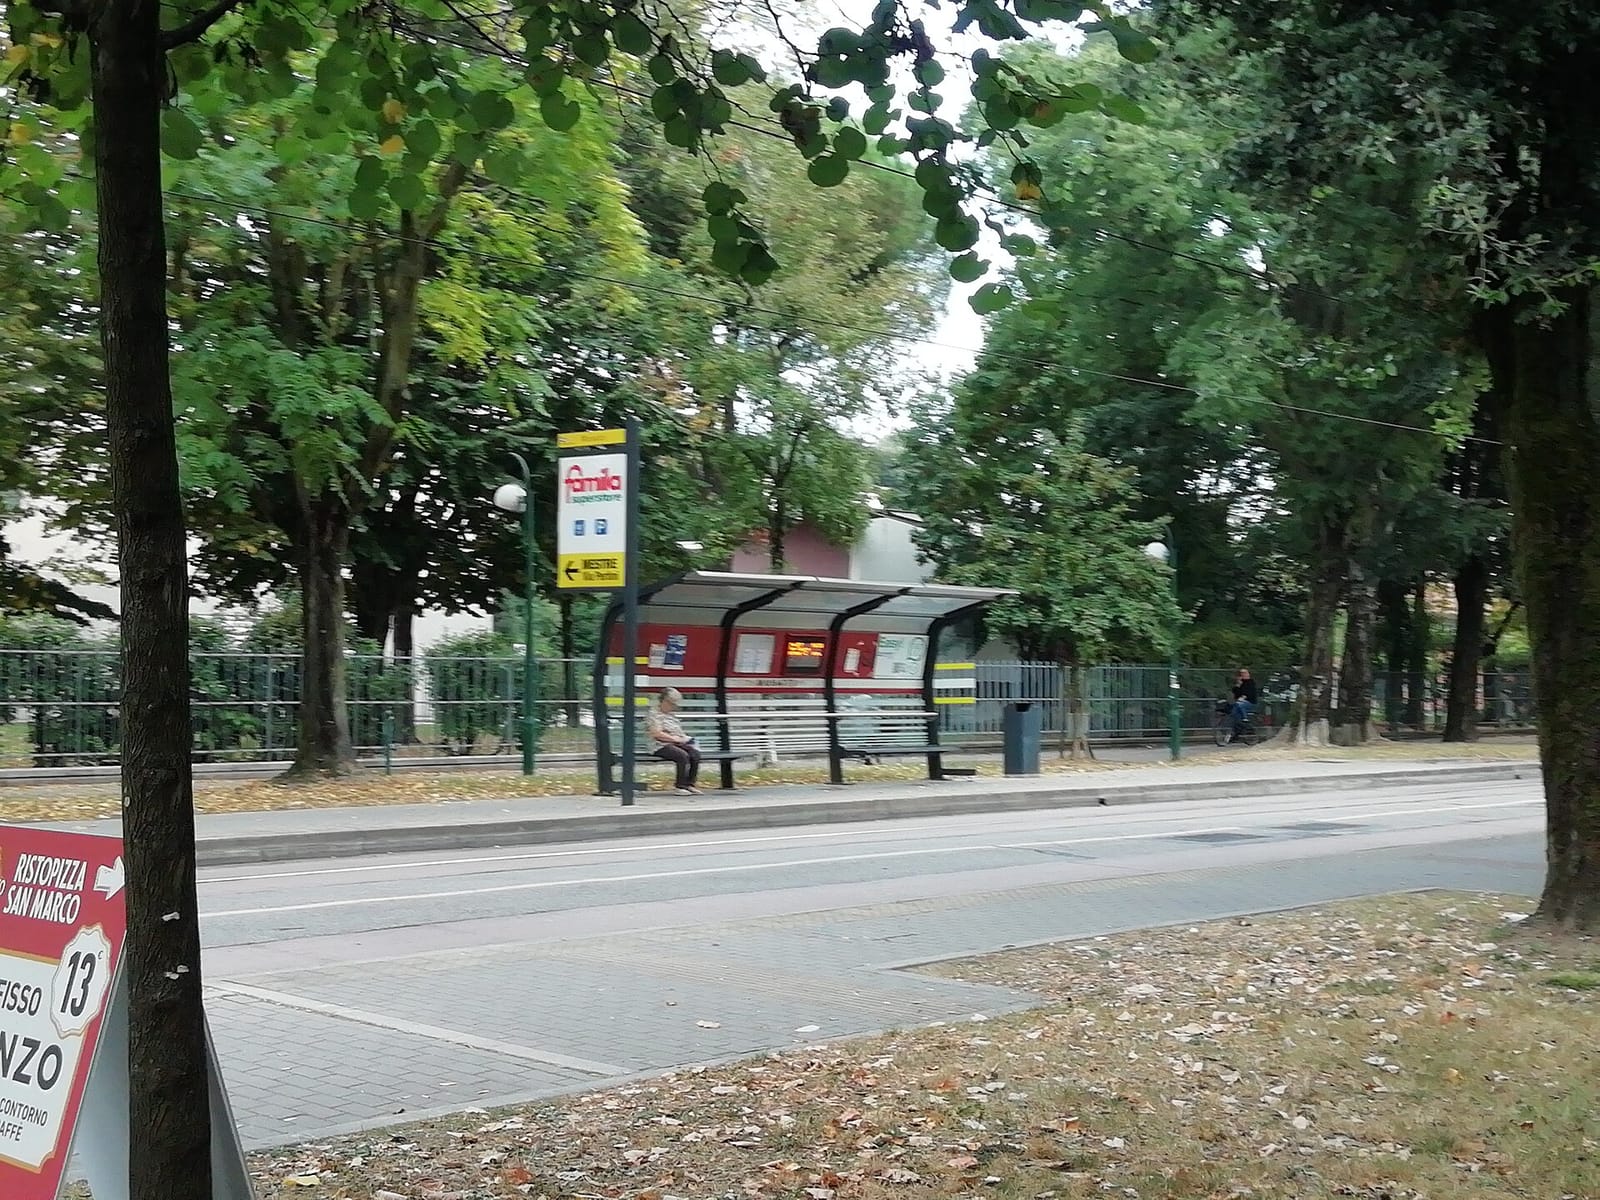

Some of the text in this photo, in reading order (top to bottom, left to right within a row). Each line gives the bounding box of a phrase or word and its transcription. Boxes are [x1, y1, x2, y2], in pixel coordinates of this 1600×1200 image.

[565, 465, 621, 503] famila
[14, 853, 87, 891] RISTOPIZZA
[3, 885, 80, 925] SAN MARCO
[0, 1098, 48, 1127] CONTORNO
